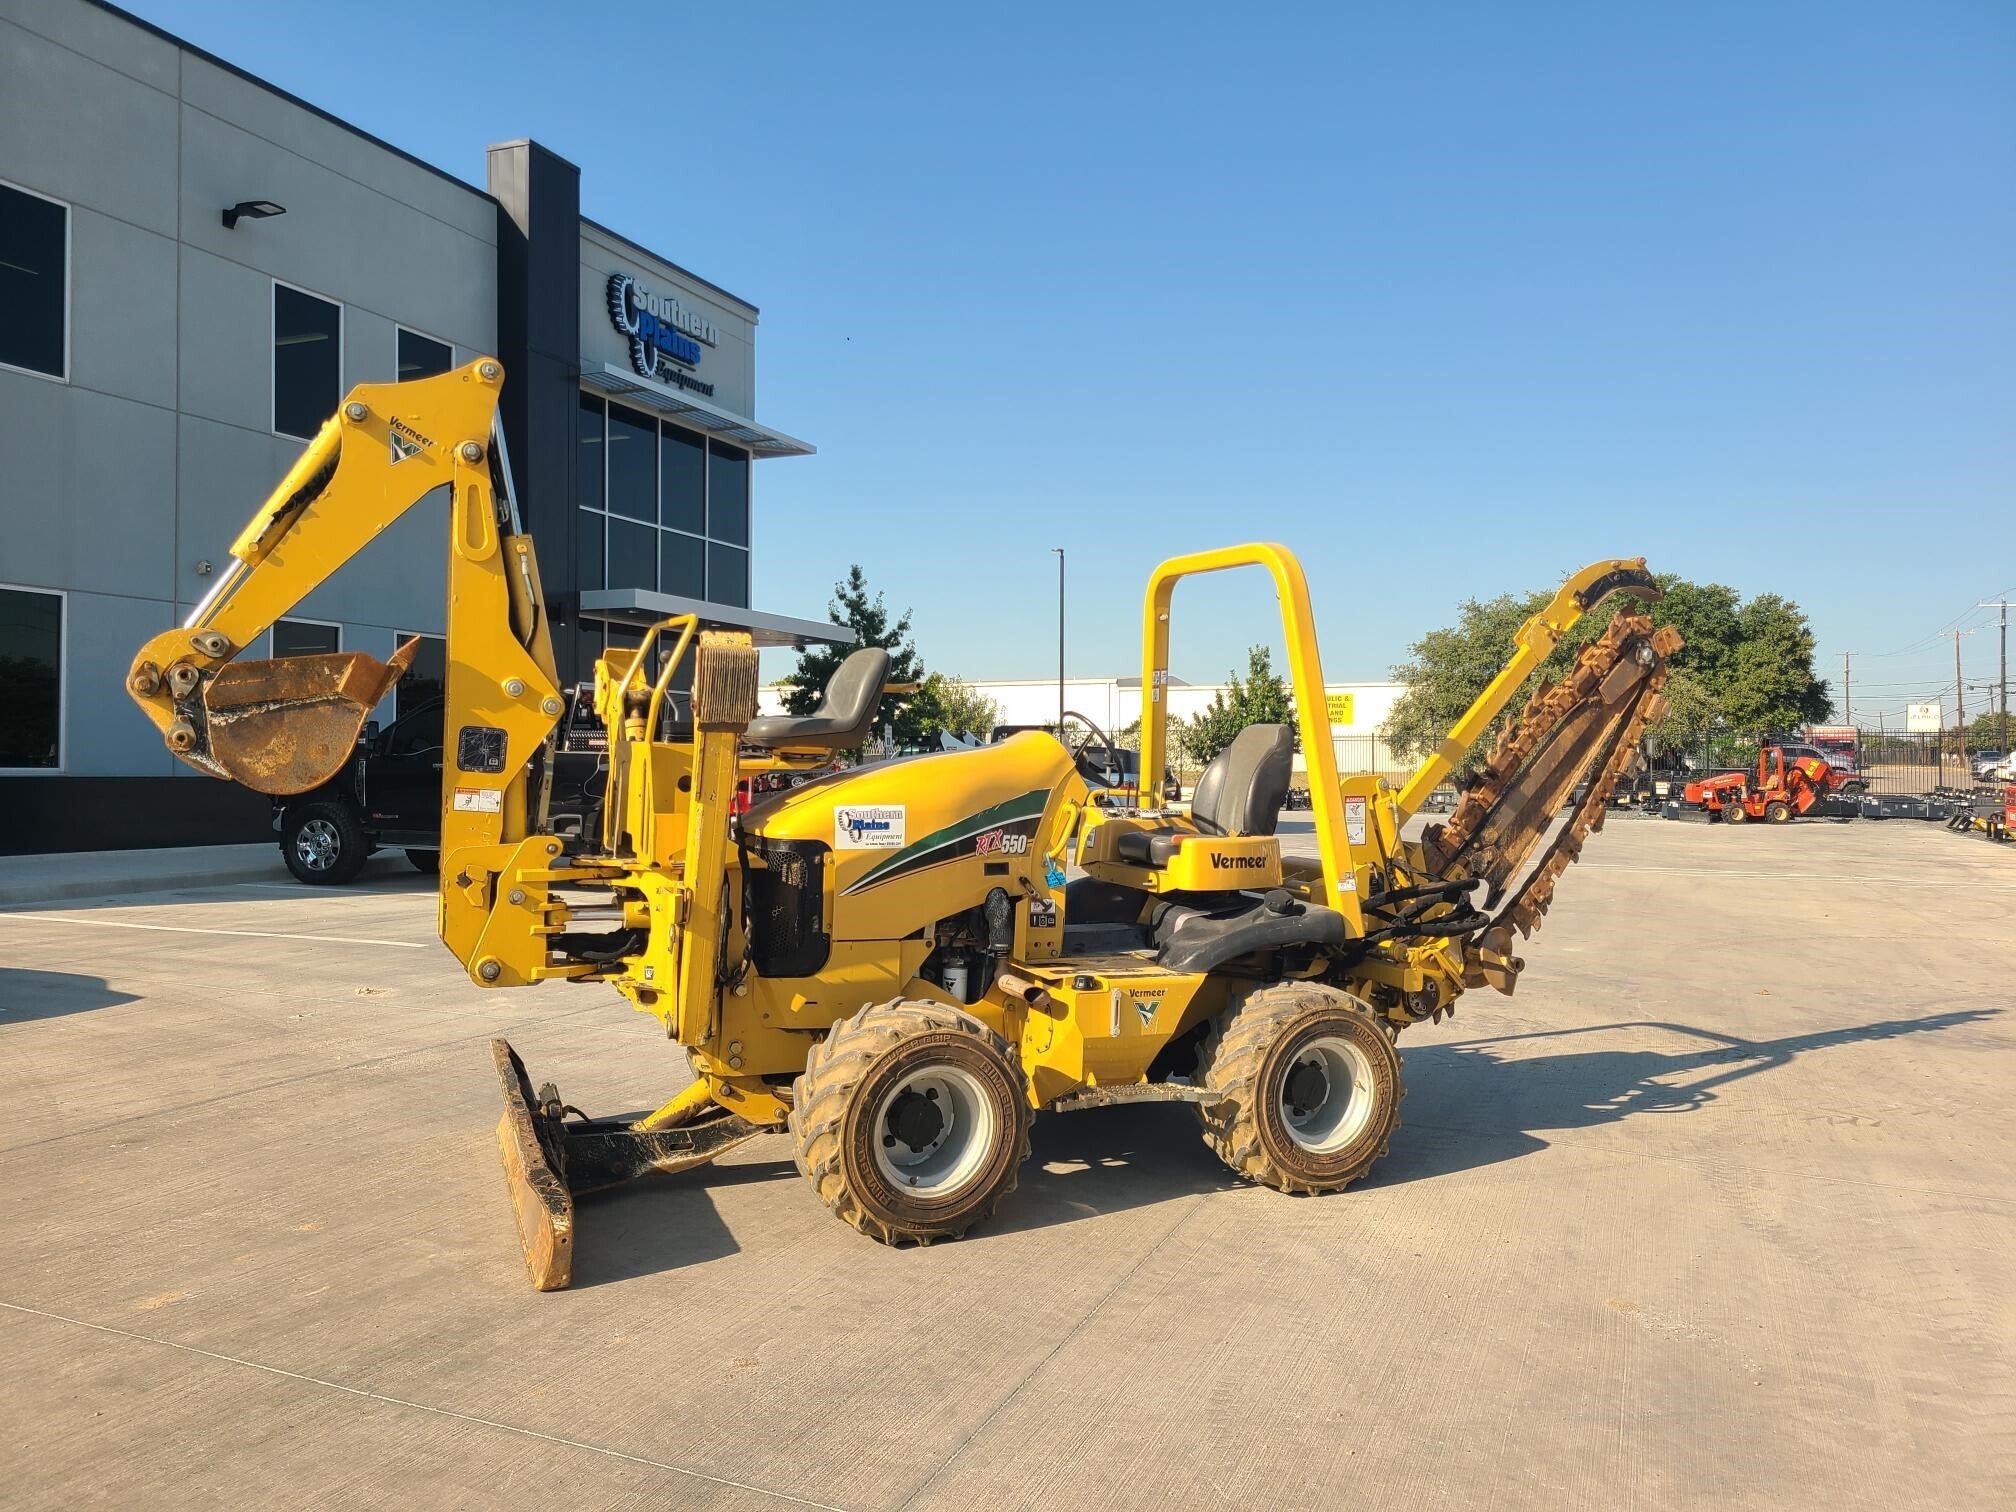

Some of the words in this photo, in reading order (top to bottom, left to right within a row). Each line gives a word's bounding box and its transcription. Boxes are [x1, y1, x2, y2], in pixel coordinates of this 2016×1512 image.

[633, 280, 720, 347] Southern
[639, 310, 701, 364] Plains
[656, 359, 714, 397] Equipment
[389, 416, 434, 447] Vermeer
[847, 808, 903, 820] Southern
[852, 819, 890, 831] Plains
[866, 833, 903, 842] Equipment
[976, 829, 1003, 857] RTX
[1001, 835, 1027, 854] 550
[1210, 852, 1267, 869] Vermeer
[1129, 988, 1166, 998] Vermeer
